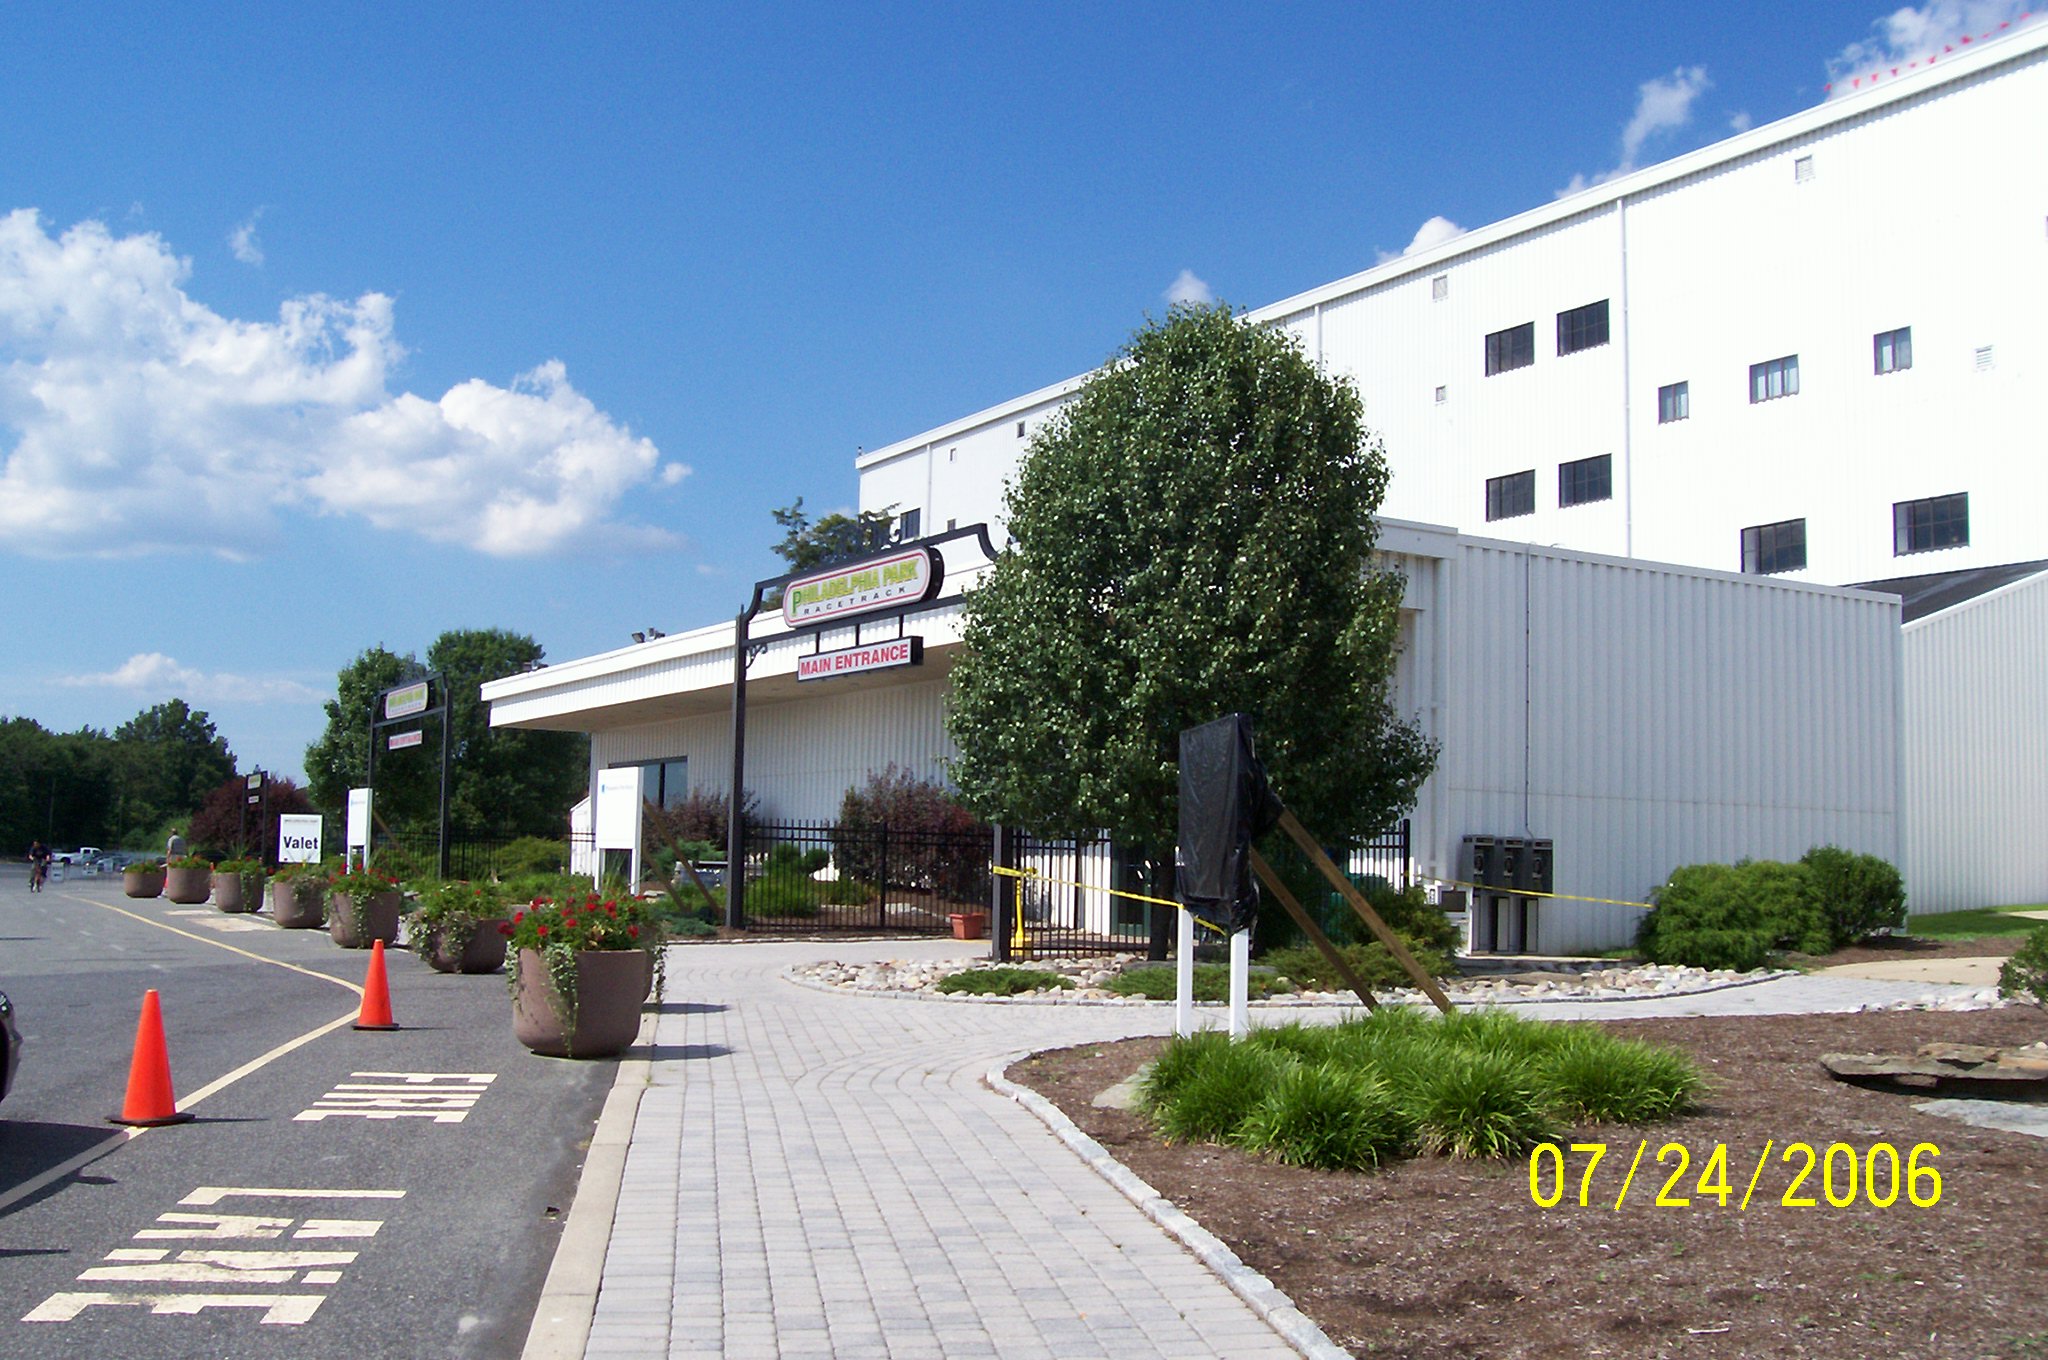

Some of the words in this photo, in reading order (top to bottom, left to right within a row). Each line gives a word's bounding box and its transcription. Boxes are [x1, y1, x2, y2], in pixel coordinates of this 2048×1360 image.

[792, 568, 880, 617] PHILADELPHIA
[882, 558, 919, 587] PARK
[803, 586, 905, 615] RACETRACK
[800, 657, 831, 676] MAIN
[835, 643, 908, 670] ENTRANCE
[283, 836, 319, 850] Valet
[293, 1072, 498, 1123] FIRE
[20, 1186, 407, 1325] LANE
